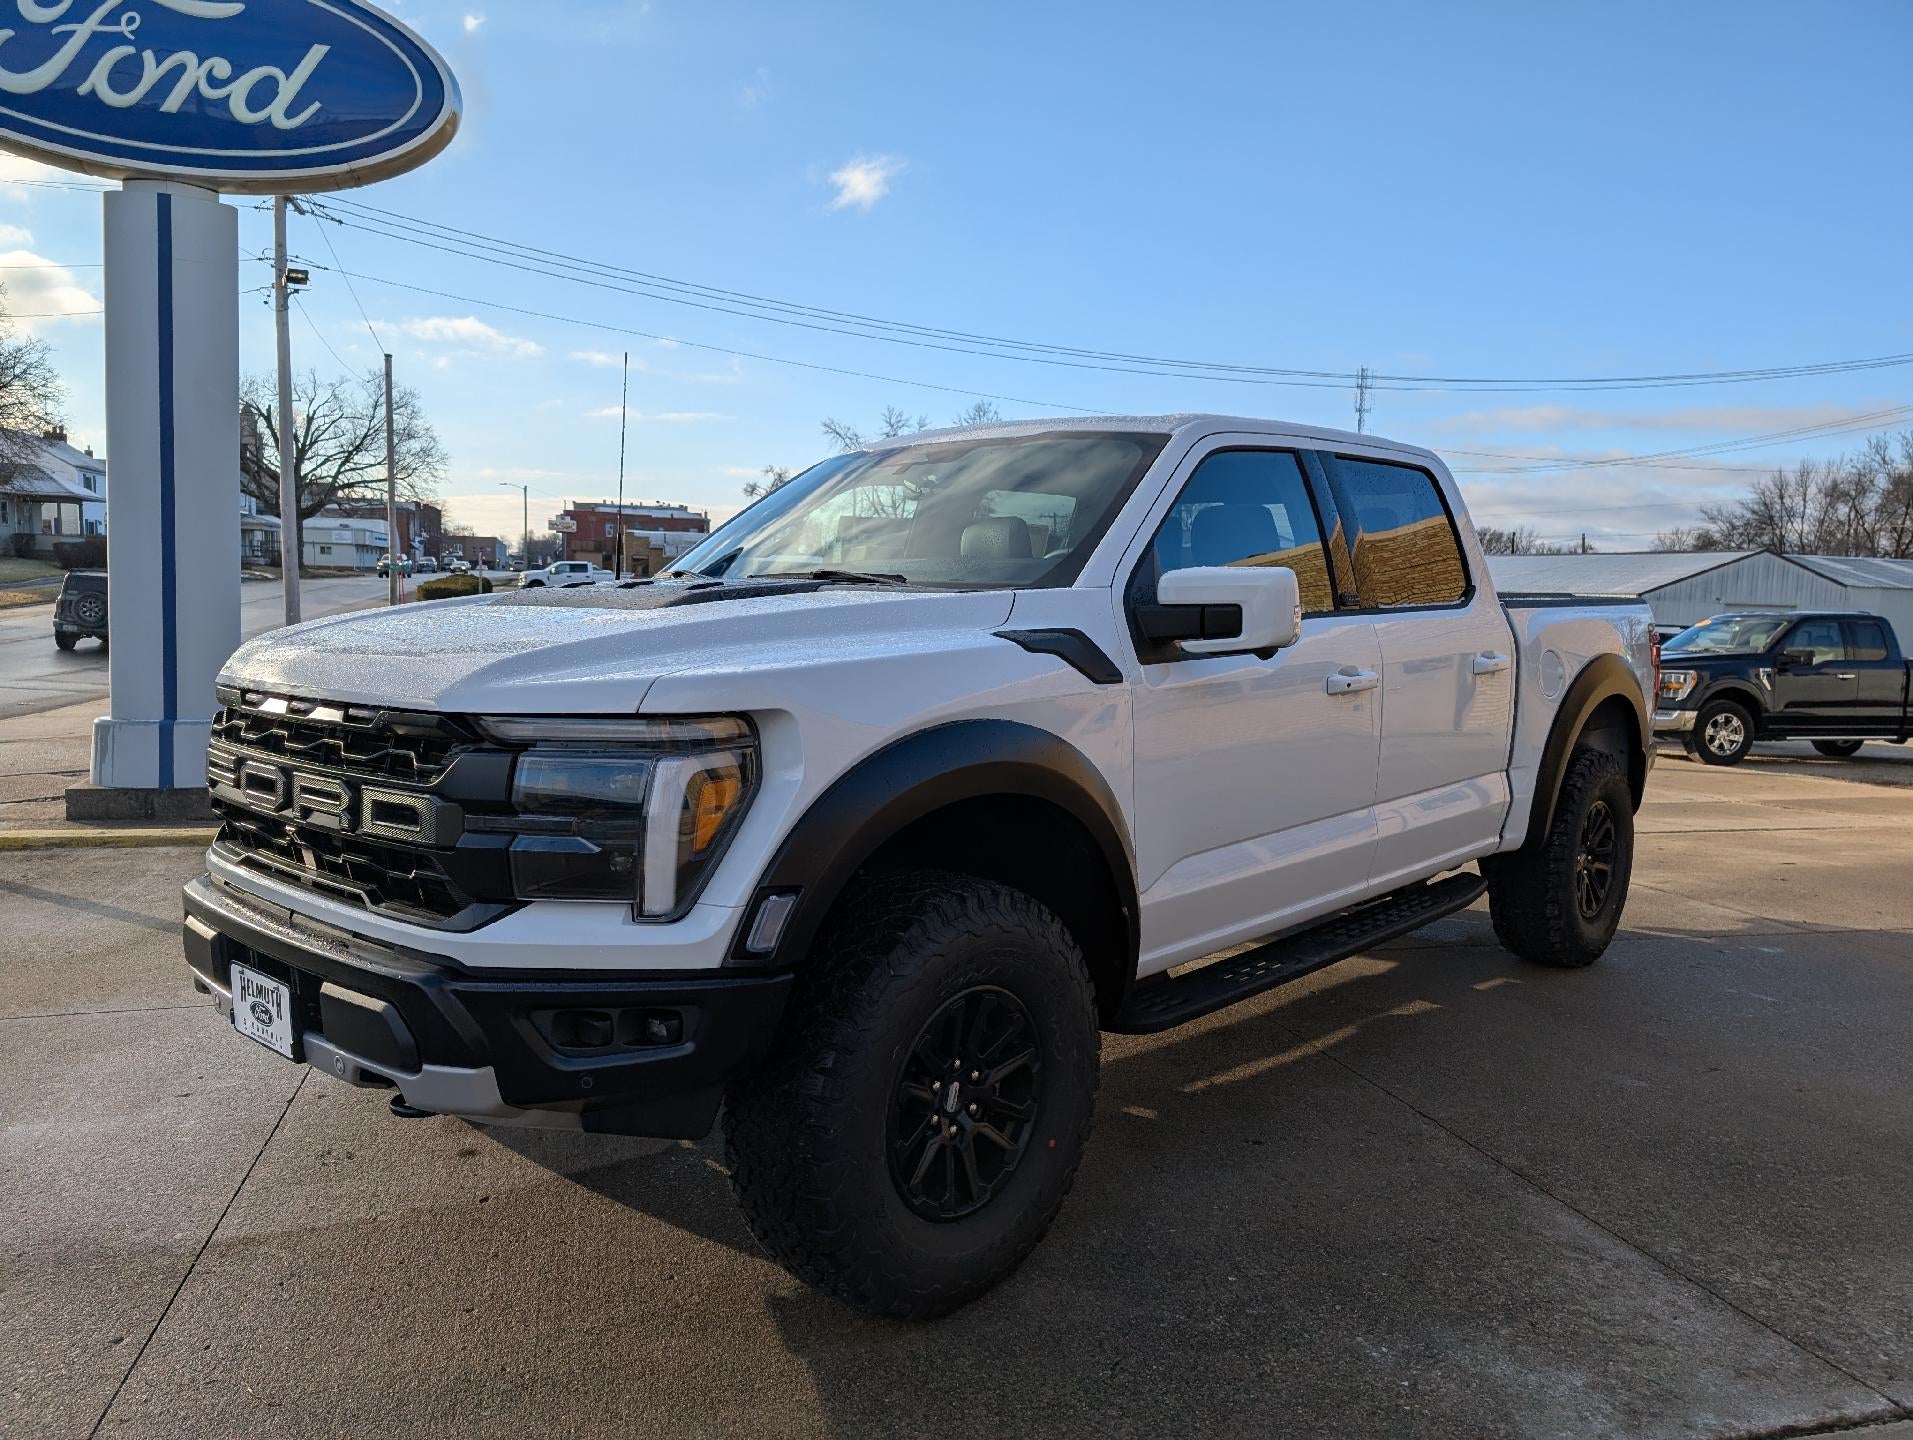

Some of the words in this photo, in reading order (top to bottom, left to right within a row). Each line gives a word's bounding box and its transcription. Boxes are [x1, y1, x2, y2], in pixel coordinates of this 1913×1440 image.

[0, 0, 332, 129] Ford
[207, 747, 440, 846] FORD
[239, 974, 283, 1020] HELMUTH
